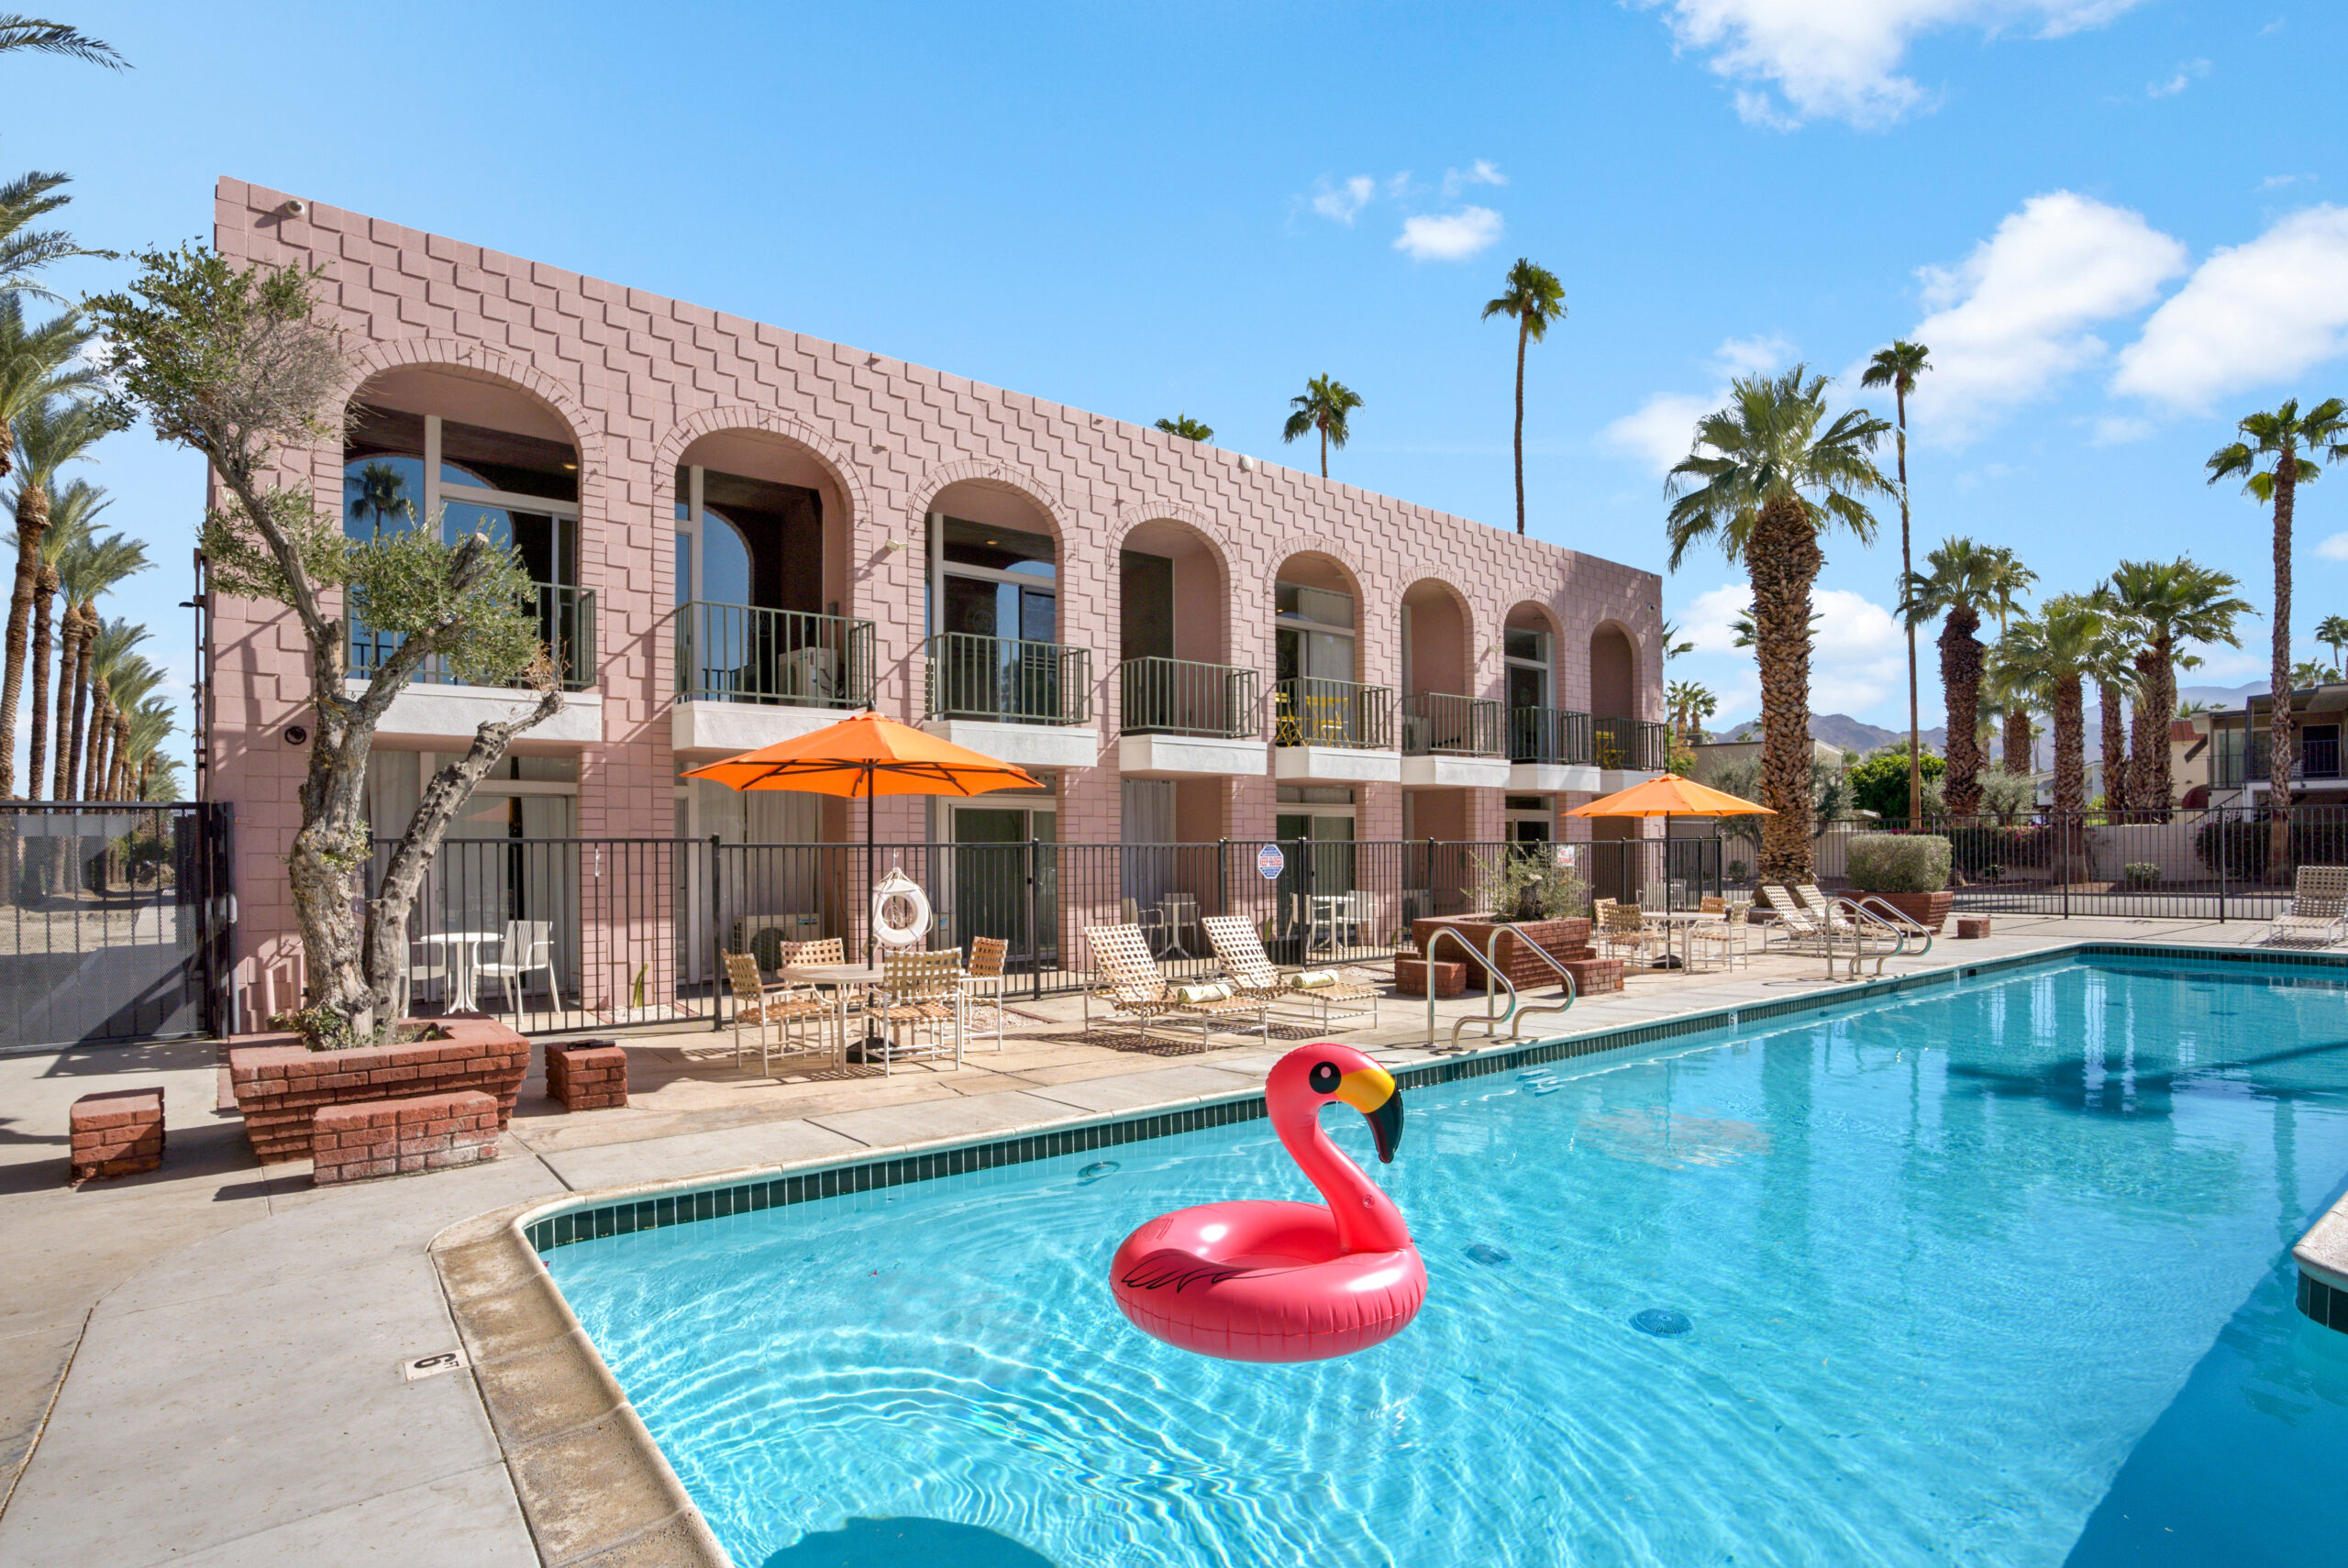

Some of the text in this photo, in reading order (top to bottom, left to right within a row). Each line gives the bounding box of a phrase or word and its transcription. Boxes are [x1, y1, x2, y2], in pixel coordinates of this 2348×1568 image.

[1729, 1014, 1734, 1025] 6
[414, 1353, 460, 1369] 6 FT
